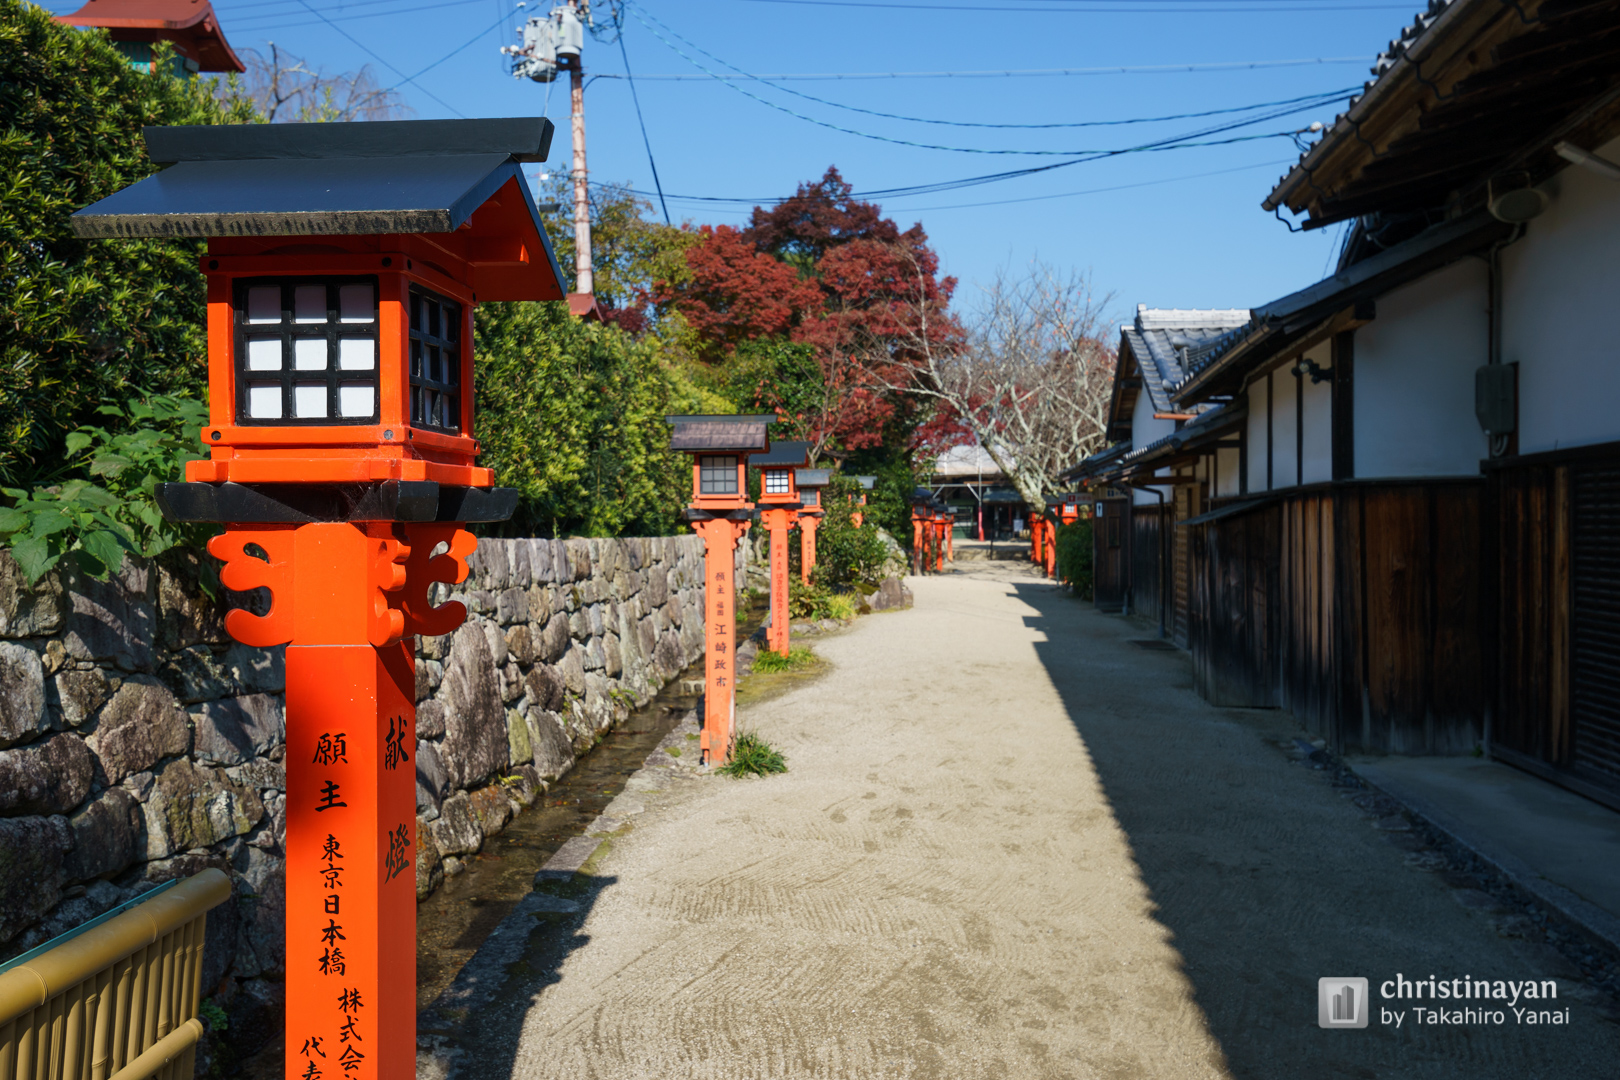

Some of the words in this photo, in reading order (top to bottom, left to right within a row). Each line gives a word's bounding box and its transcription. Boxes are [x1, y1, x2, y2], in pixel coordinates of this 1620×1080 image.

[312, 732, 349, 812] 願主
[318, 833, 347, 976] 東京日本橋
[337, 987, 366, 1080] 株式会
